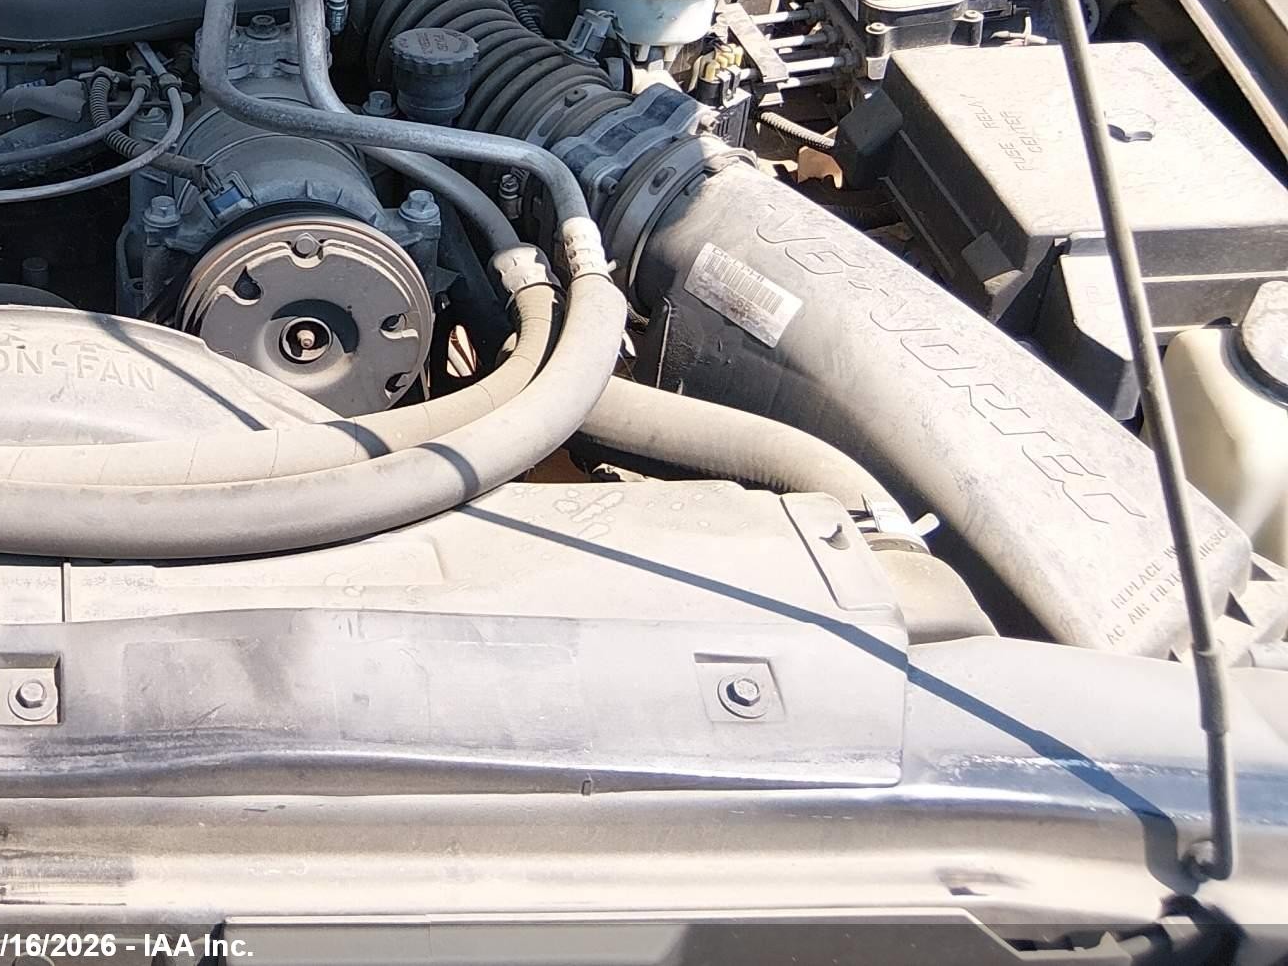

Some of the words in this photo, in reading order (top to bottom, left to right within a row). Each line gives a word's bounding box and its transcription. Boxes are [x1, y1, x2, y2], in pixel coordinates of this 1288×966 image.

[998, 138, 1035, 172] FUSE
[1110, 559, 1162, 610] REPLACE
[1105, 623, 1127, 646] AC
[1127, 602, 1152, 626] AIR
